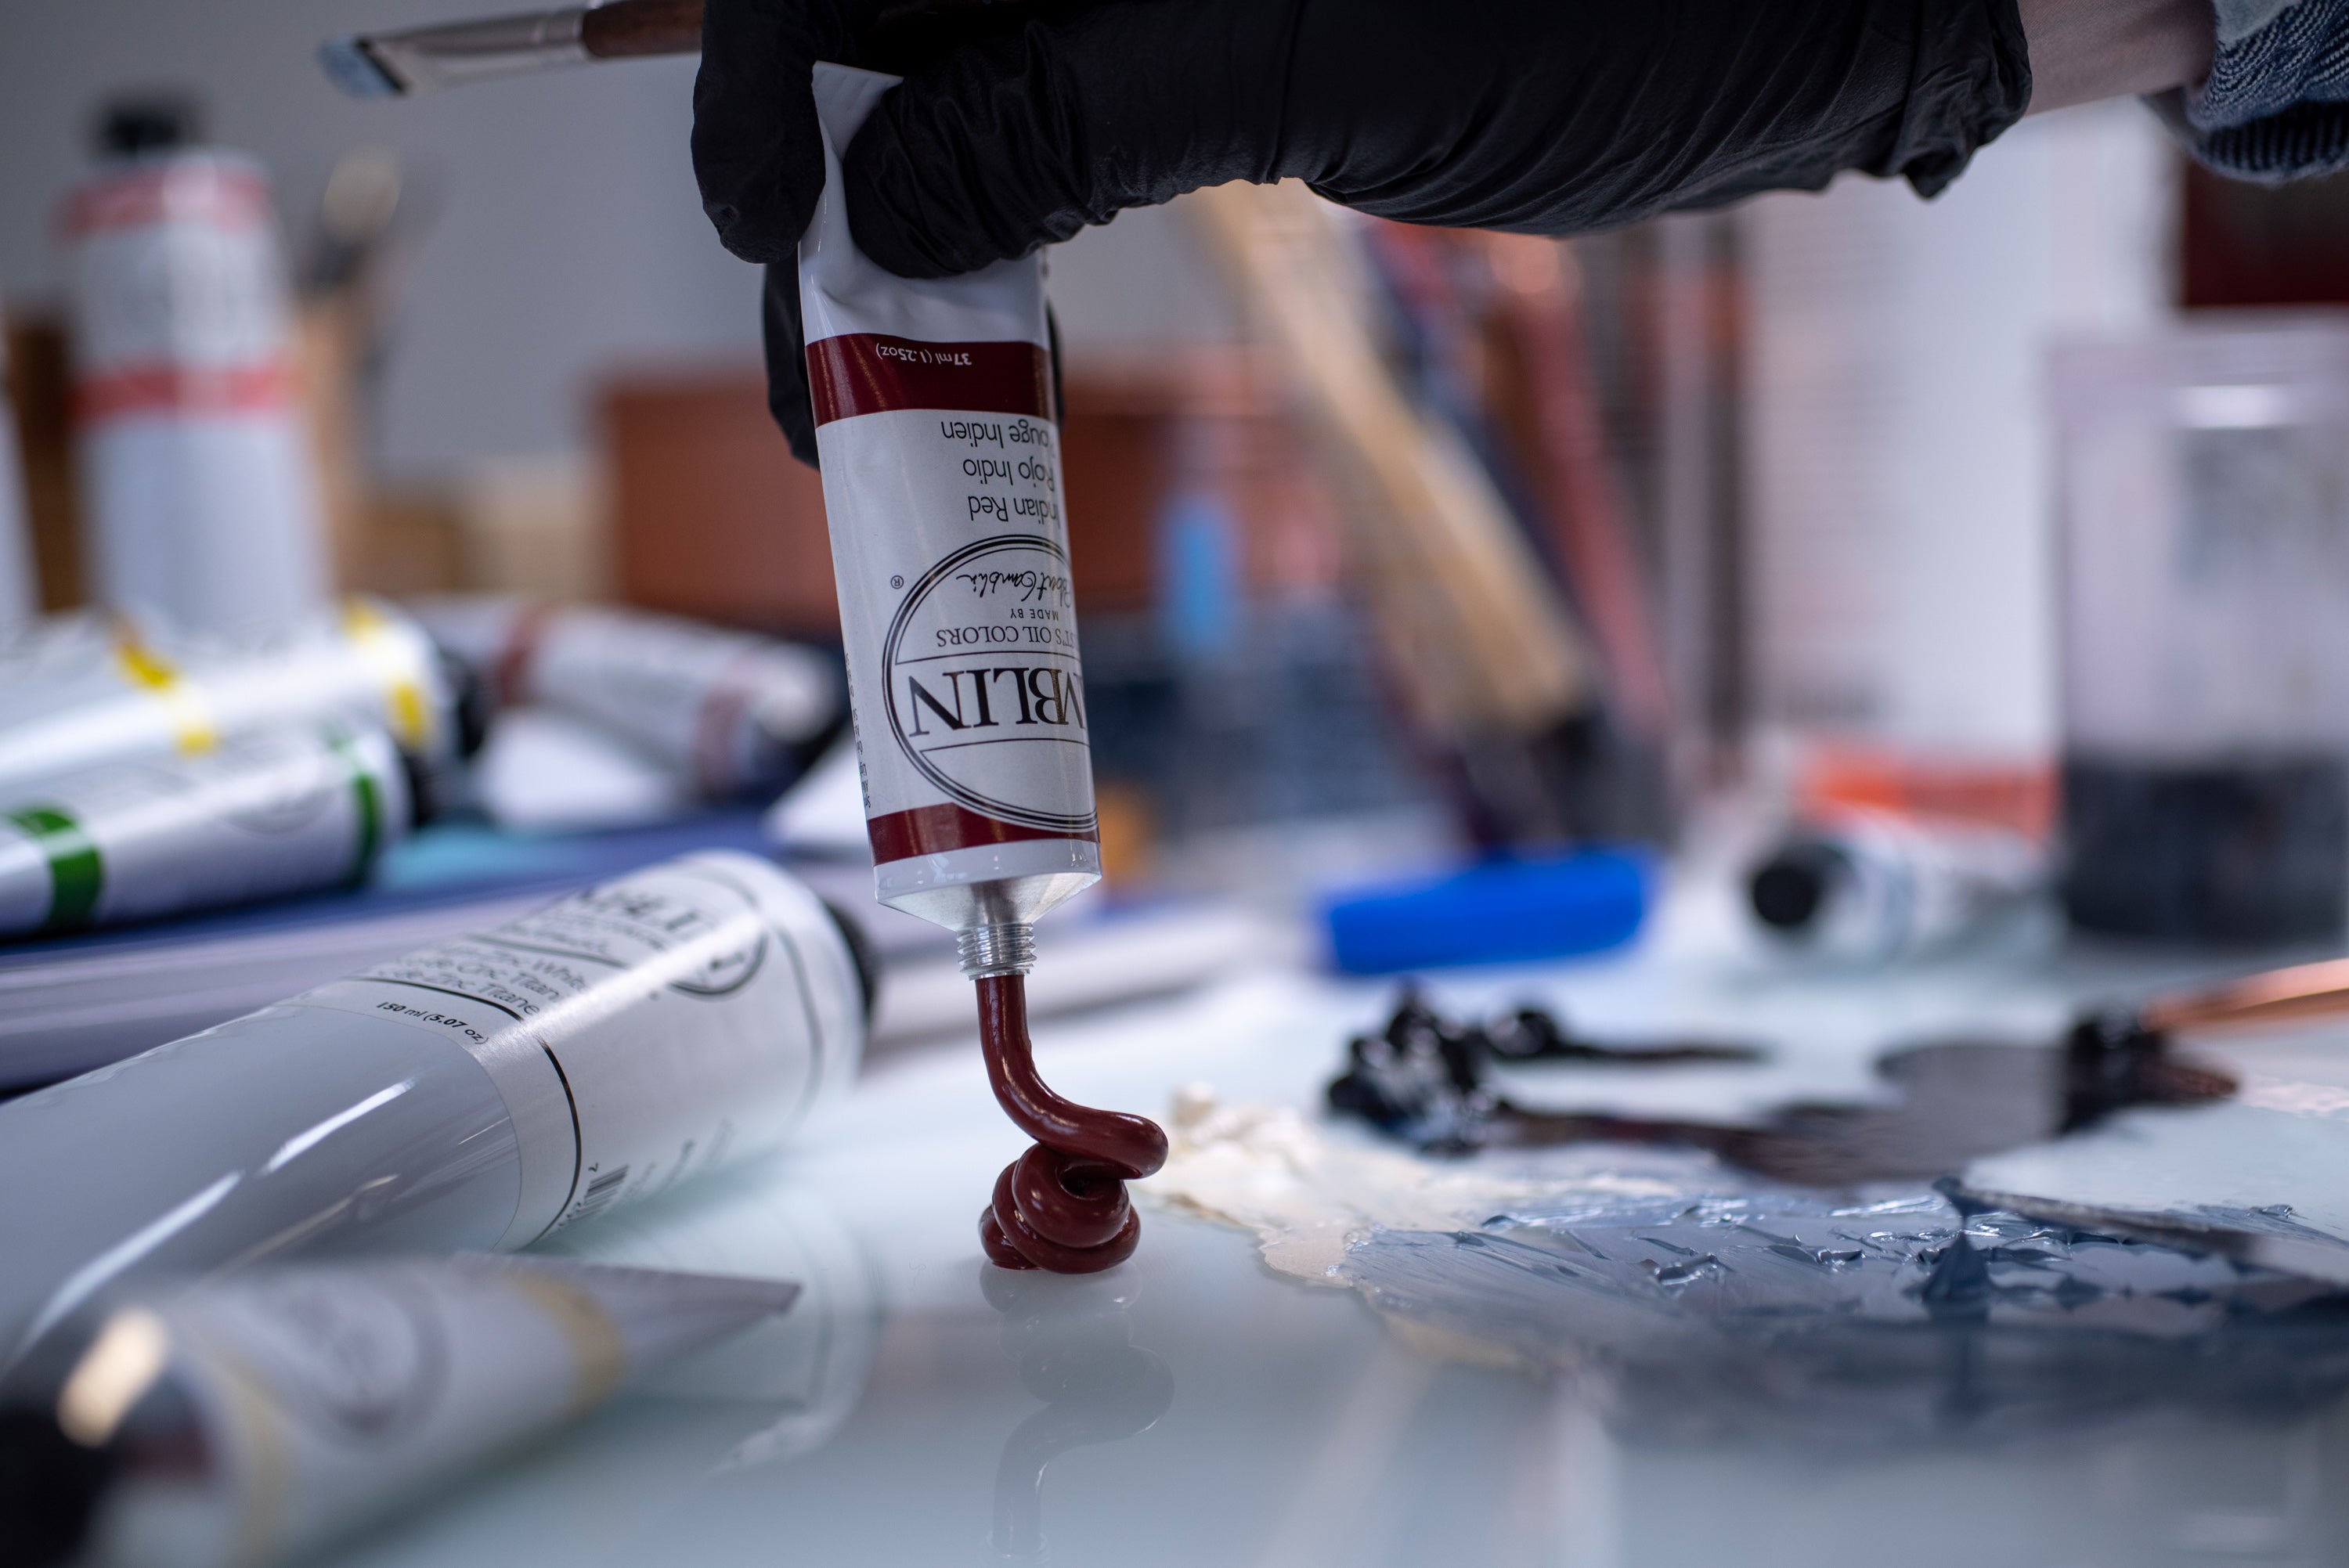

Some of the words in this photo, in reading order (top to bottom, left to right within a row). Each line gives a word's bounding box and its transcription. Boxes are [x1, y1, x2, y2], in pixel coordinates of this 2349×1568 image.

[875, 343, 932, 363] (1.25oz)
[941, 421, 1004, 449] Indien
[1009, 419, 1053, 452] ouge
[963, 460, 1013, 485] Indio
[1019, 456, 1055, 492] Rojo
[968, 496, 1009, 521] Red
[1014, 497, 1060, 529] Indian
[1010, 608, 1024, 618] BY
[1030, 609, 1059, 621] MADE
[936, 626, 1019, 647] COLORS
[1023, 627, 1052, 643] OIL
[909, 668, 1086, 737] MBLIN
[377, 1002, 406, 1013] 150
[404, 1007, 427, 1018] ml
[423, 1013, 468, 1028] (5.07
[464, 1029, 489, 1045] oz)
